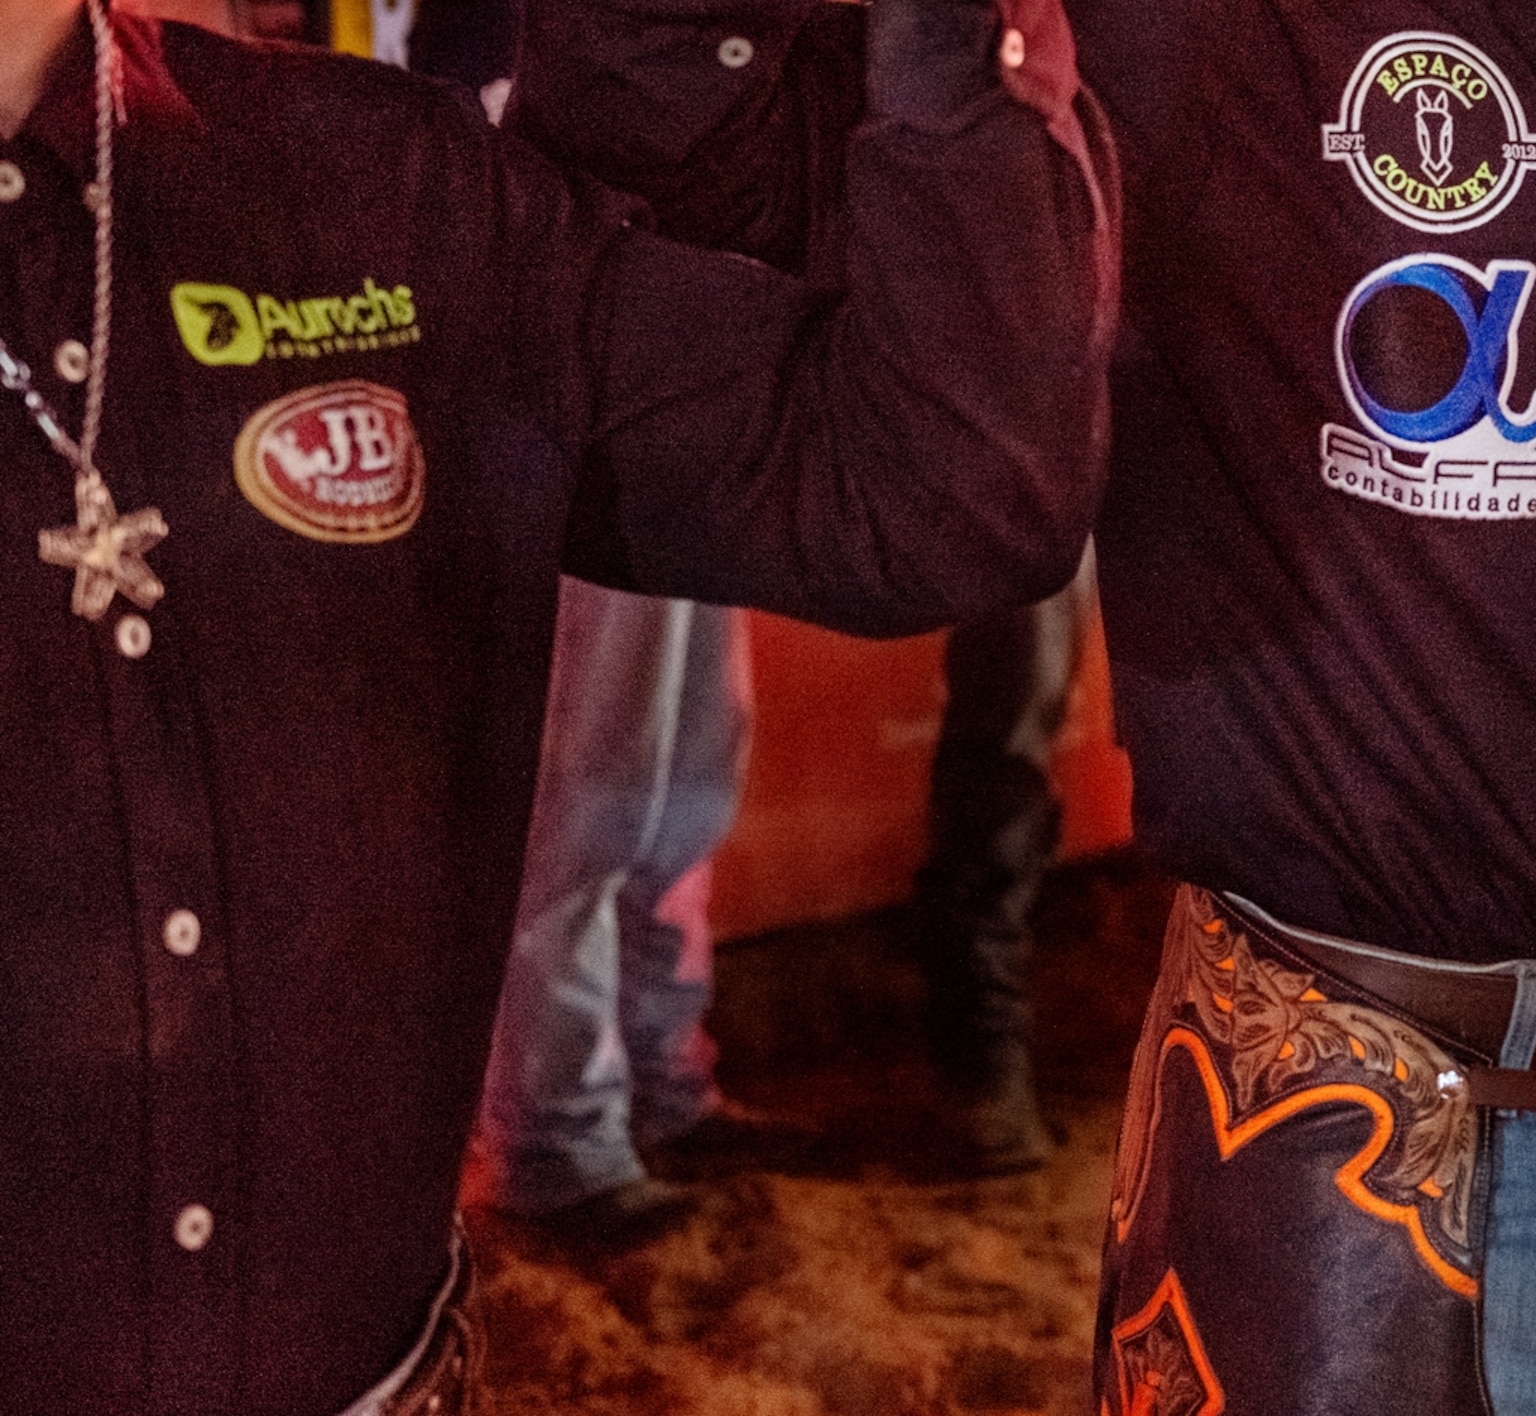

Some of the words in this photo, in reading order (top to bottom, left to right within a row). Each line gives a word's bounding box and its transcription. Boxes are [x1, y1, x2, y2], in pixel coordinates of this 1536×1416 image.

[1377, 54, 1488, 102] ESPAÇO
[1502, 143, 1536, 160] 2012
[1373, 153, 1498, 210] COUNTRY
[314, 405, 392, 476] JB
